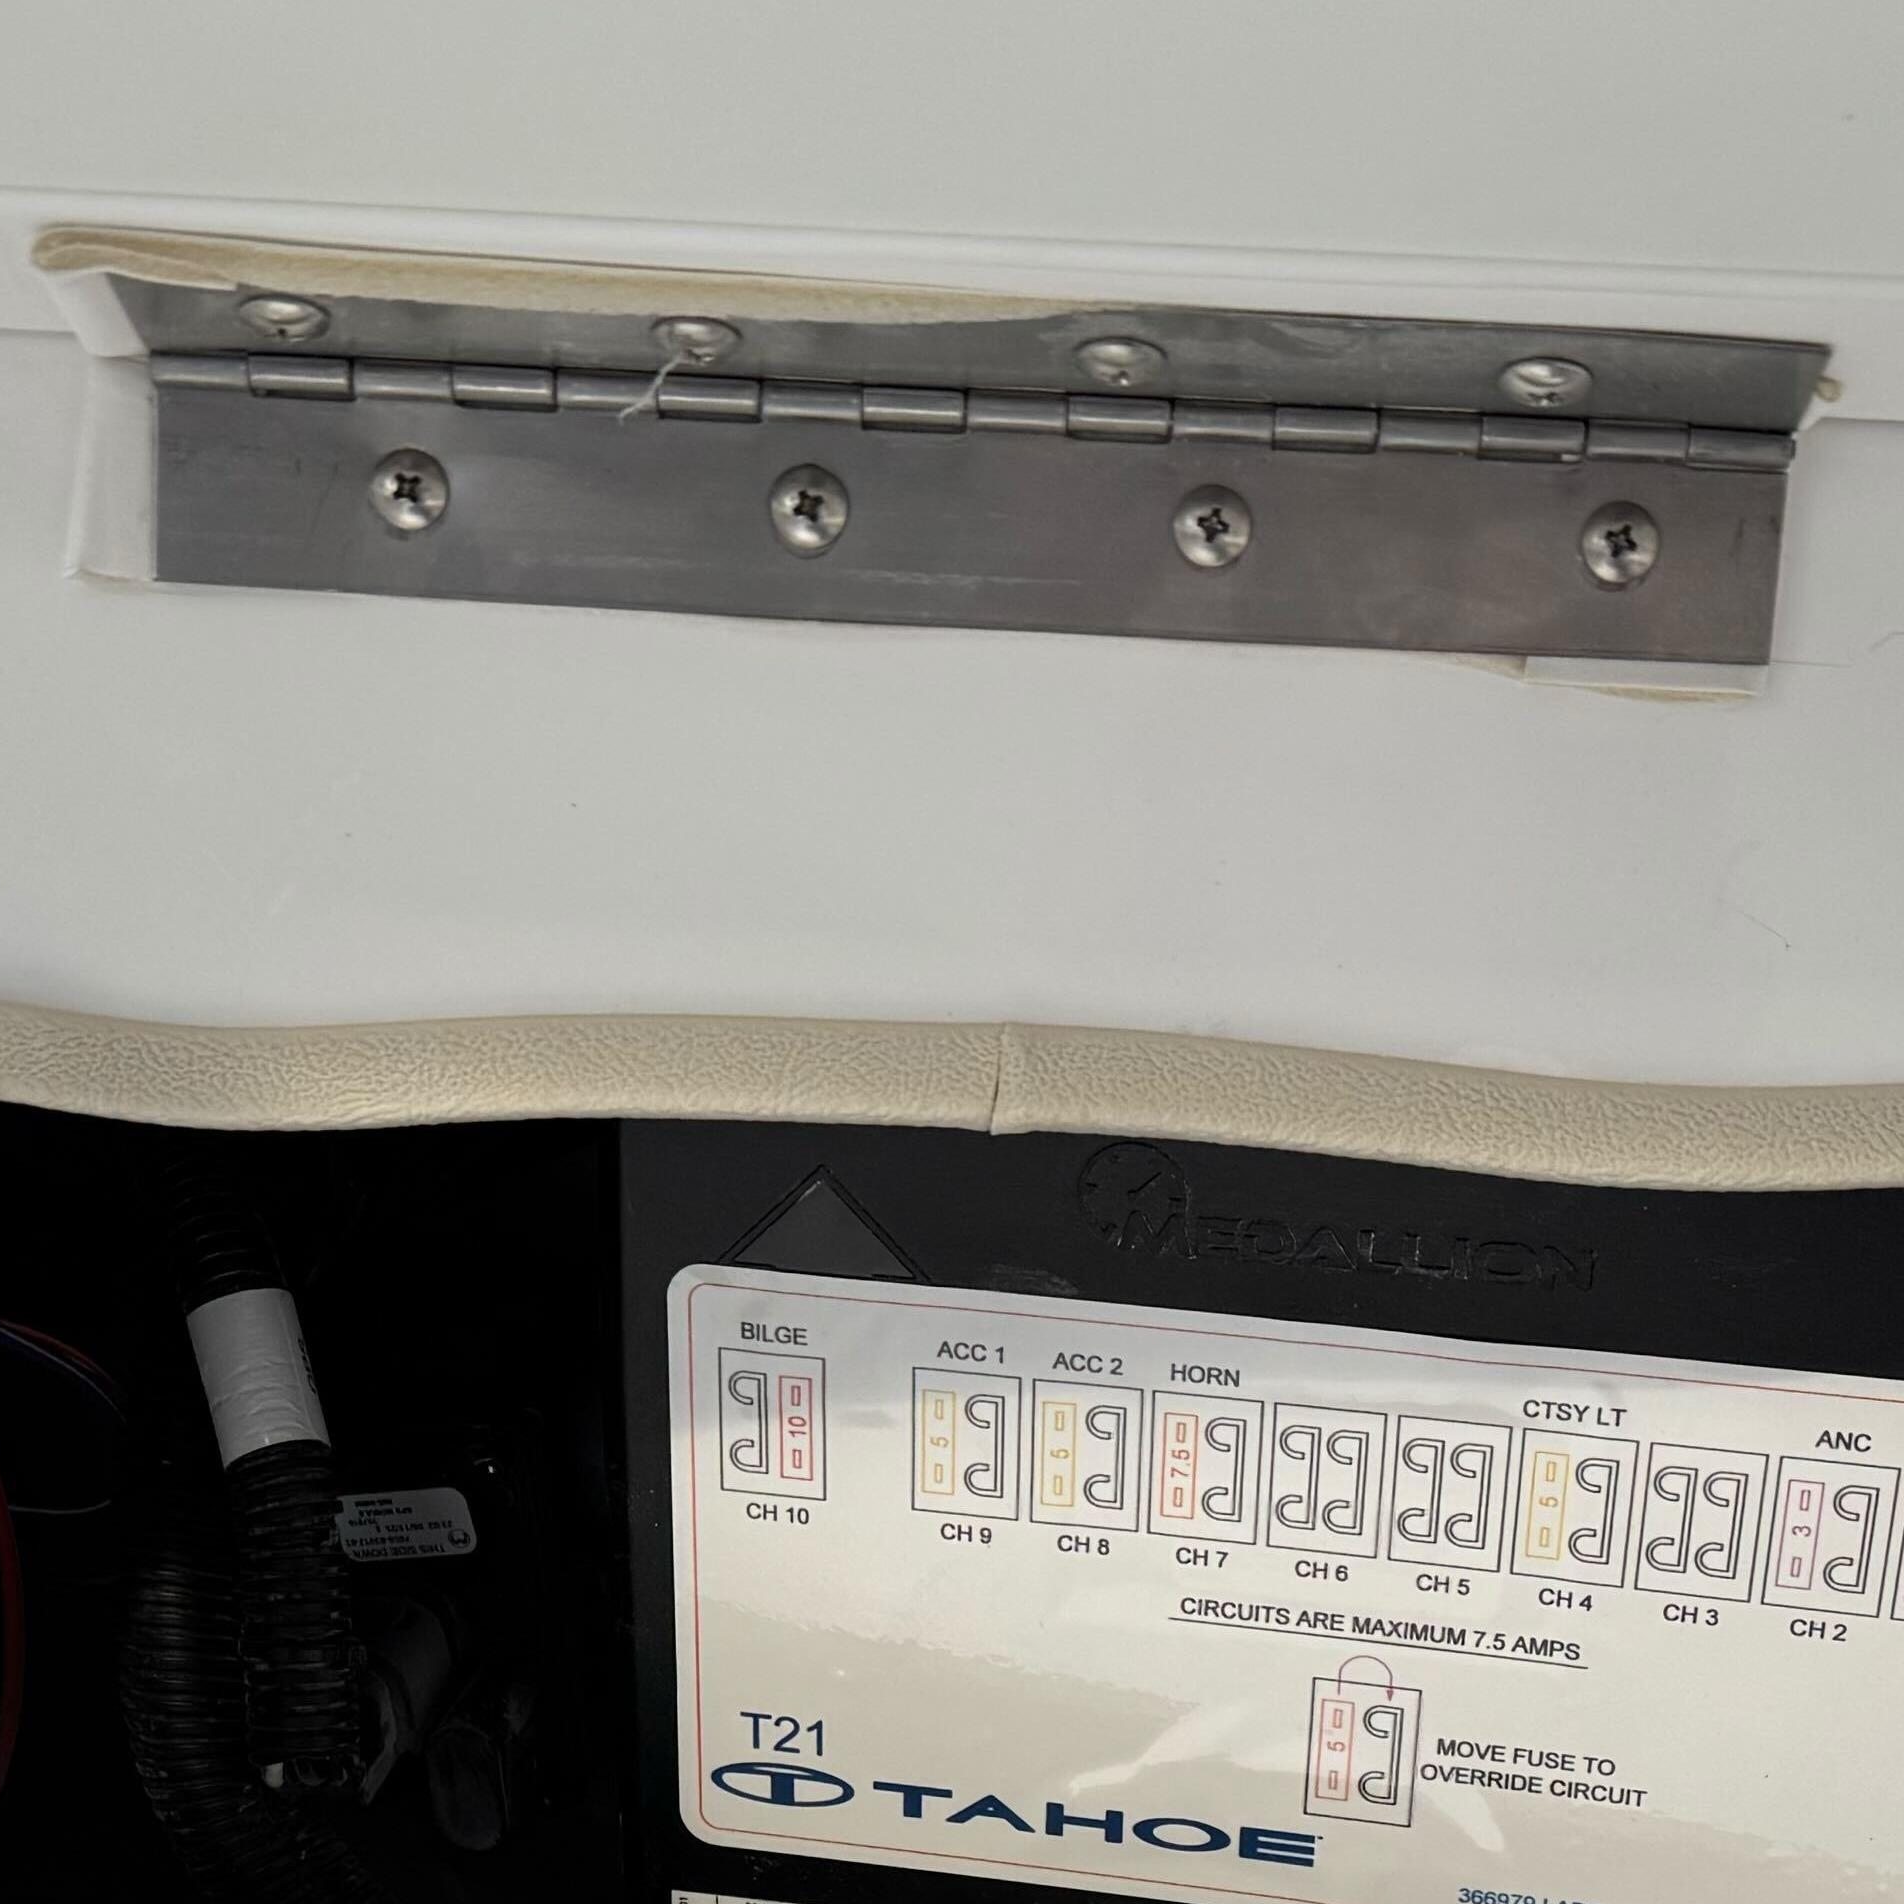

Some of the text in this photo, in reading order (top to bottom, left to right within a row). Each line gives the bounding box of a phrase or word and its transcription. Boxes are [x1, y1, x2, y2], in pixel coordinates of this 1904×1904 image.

[1108, 1209, 1597, 1292] MEDALLION
[739, 1321, 808, 1346] BILGE
[936, 1340, 1005, 1364] ACC 1
[1052, 1352, 1124, 1376] ACC 2
[1170, 1363, 1240, 1388] HORN
[1522, 1399, 1628, 1427] CTSY LT
[1815, 1429, 1872, 1453] ANC
[746, 1502, 811, 1526] CH 10
[940, 1522, 993, 1545] CH 9
[1056, 1534, 1110, 1556] CH 8
[1175, 1546, 1229, 1569] CH 7
[1294, 1560, 1349, 1582] CH 6
[1415, 1573, 1471, 1596] CH 5
[1538, 1587, 1594, 1612] CH 4
[1662, 1603, 1720, 1627] CH 3
[1180, 1597, 1581, 1661] CIRCUITS ARE MAXIMUM 7.5 AMPS
[1789, 1618, 1848, 1642] CH 2
[739, 1711, 823, 1757] T21
[1436, 1737, 1616, 1777] MOVE FUSE TO
[1420, 1763, 1648, 1808] OVERRIDE CIRCUIT
[872, 1780, 1316, 1868] TAHOE
